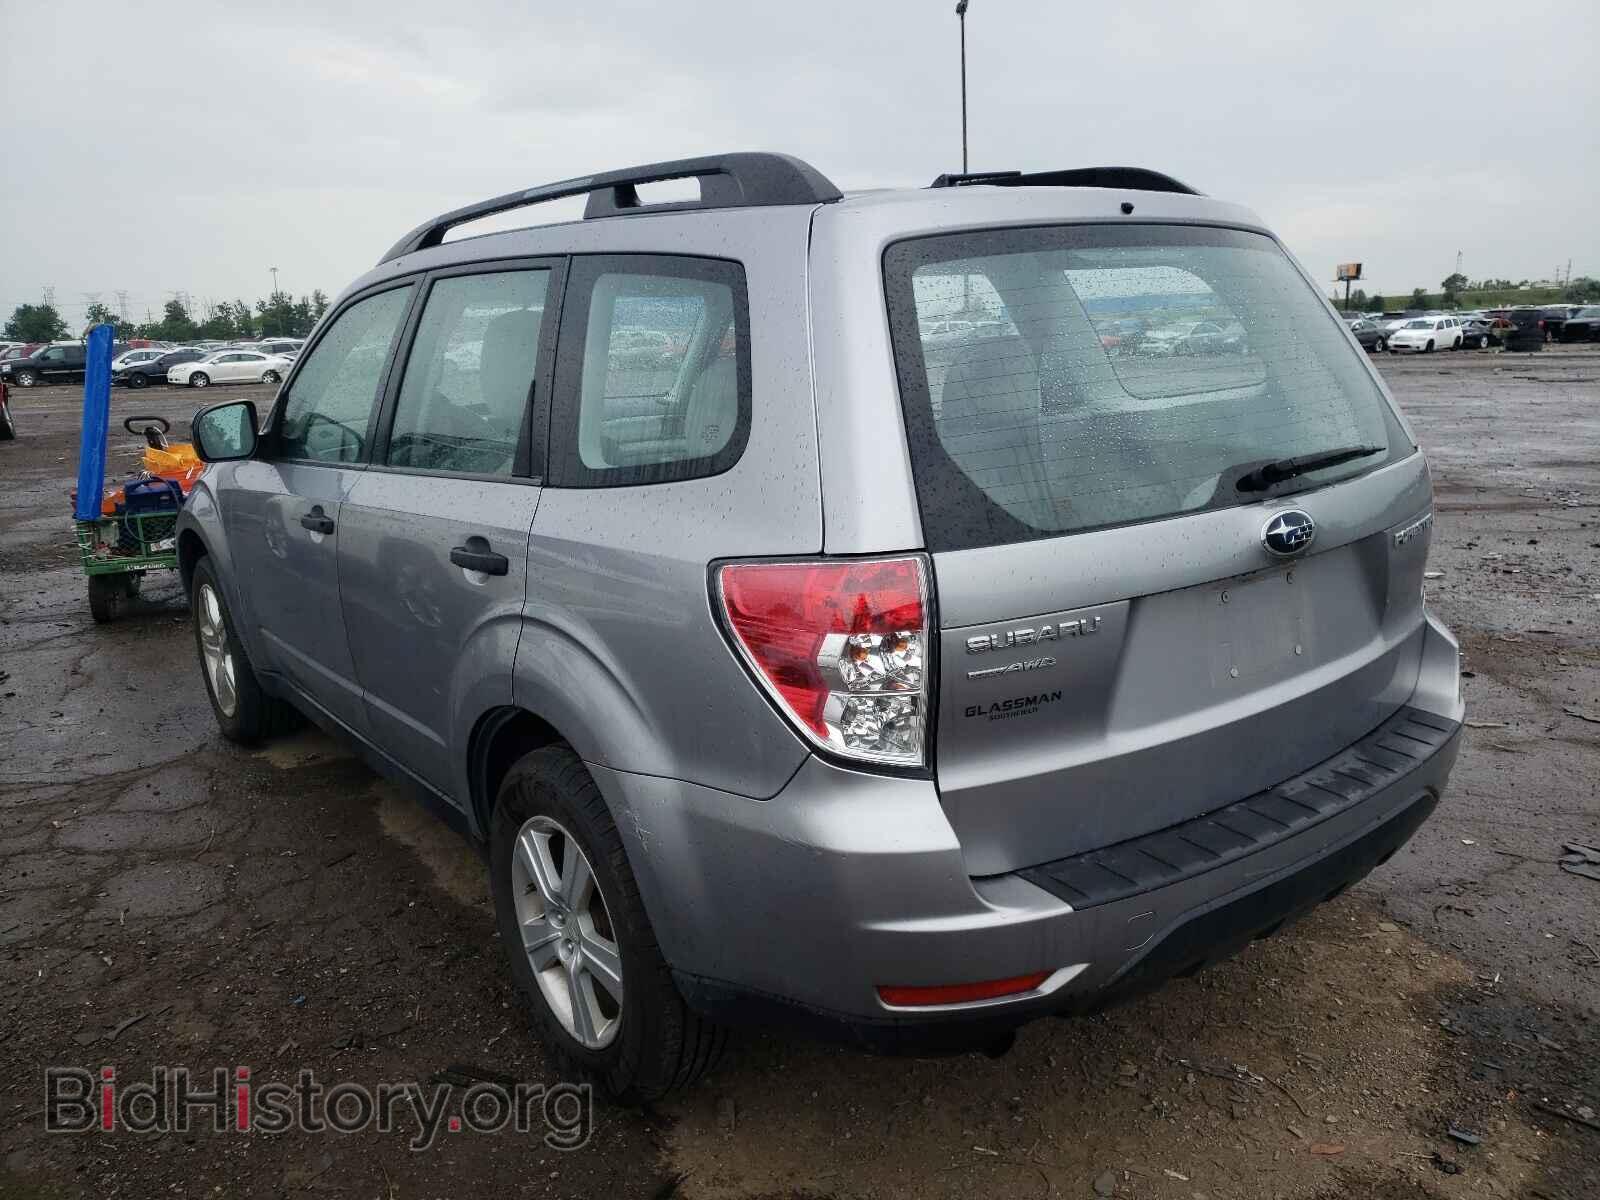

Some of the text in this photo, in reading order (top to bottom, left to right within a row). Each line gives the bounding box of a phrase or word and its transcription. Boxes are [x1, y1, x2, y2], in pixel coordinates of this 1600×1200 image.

[966, 616, 1104, 653] SUBARU
[1004, 656, 1057, 673] AWD
[964, 690, 1063, 718] GLASSMAN
